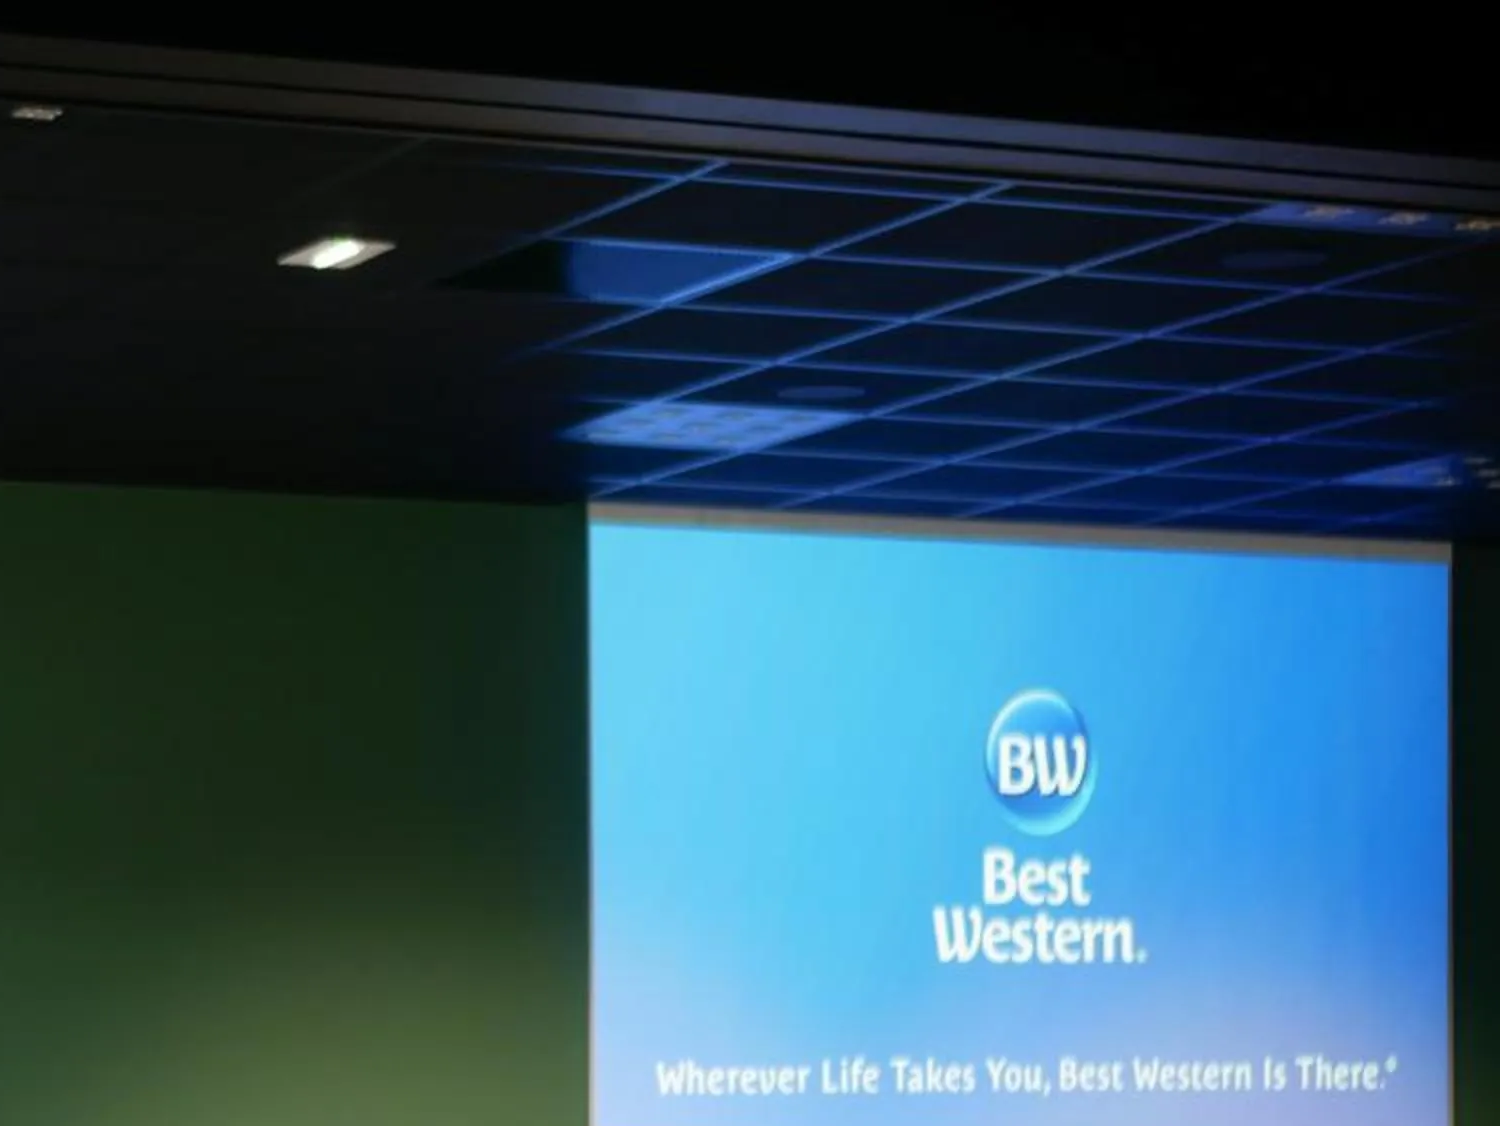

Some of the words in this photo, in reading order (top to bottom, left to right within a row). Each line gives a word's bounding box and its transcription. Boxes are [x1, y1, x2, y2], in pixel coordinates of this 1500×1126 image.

[998, 733, 1087, 796] BW
[982, 846, 1092, 906] Best
[656, 1060, 811, 1095] Wherever
[821, 1056, 881, 1094] Life
[890, 1056, 976, 1093] Takes
[986, 1057, 1051, 1096] You,
[1059, 1056, 1122, 1091] Best
[1133, 1056, 1252, 1091] Western
[1263, 1056, 1287, 1090] Is
